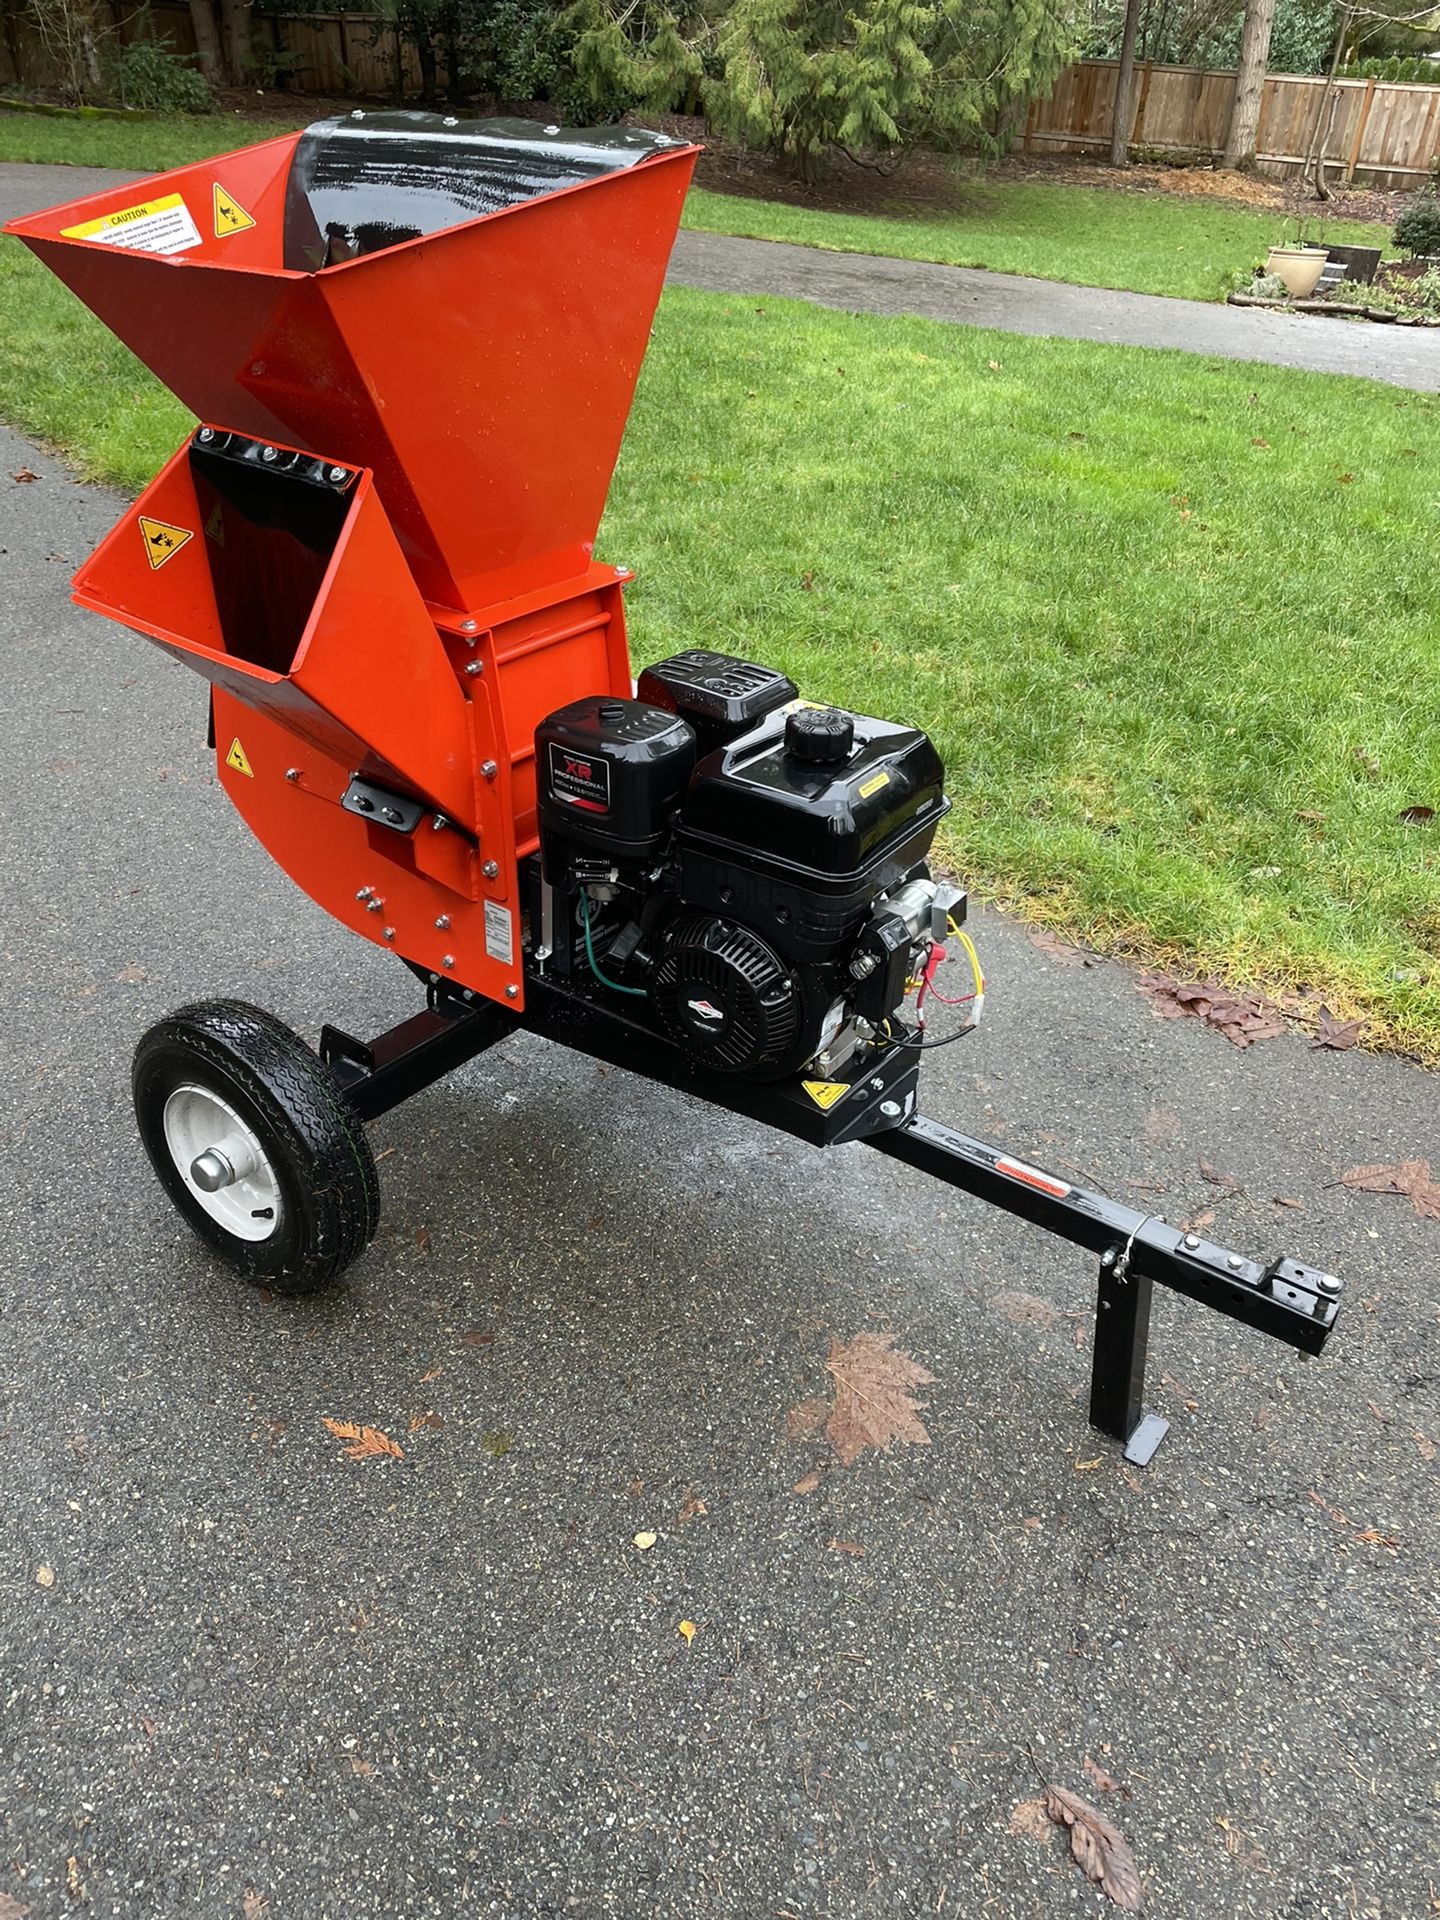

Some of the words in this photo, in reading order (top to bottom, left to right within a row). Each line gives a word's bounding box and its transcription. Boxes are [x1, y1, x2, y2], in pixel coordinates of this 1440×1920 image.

[111, 208, 148, 225] CAUTION
[554, 769, 606, 791] PROFESSIONAL
[565, 759, 592, 780] XR
